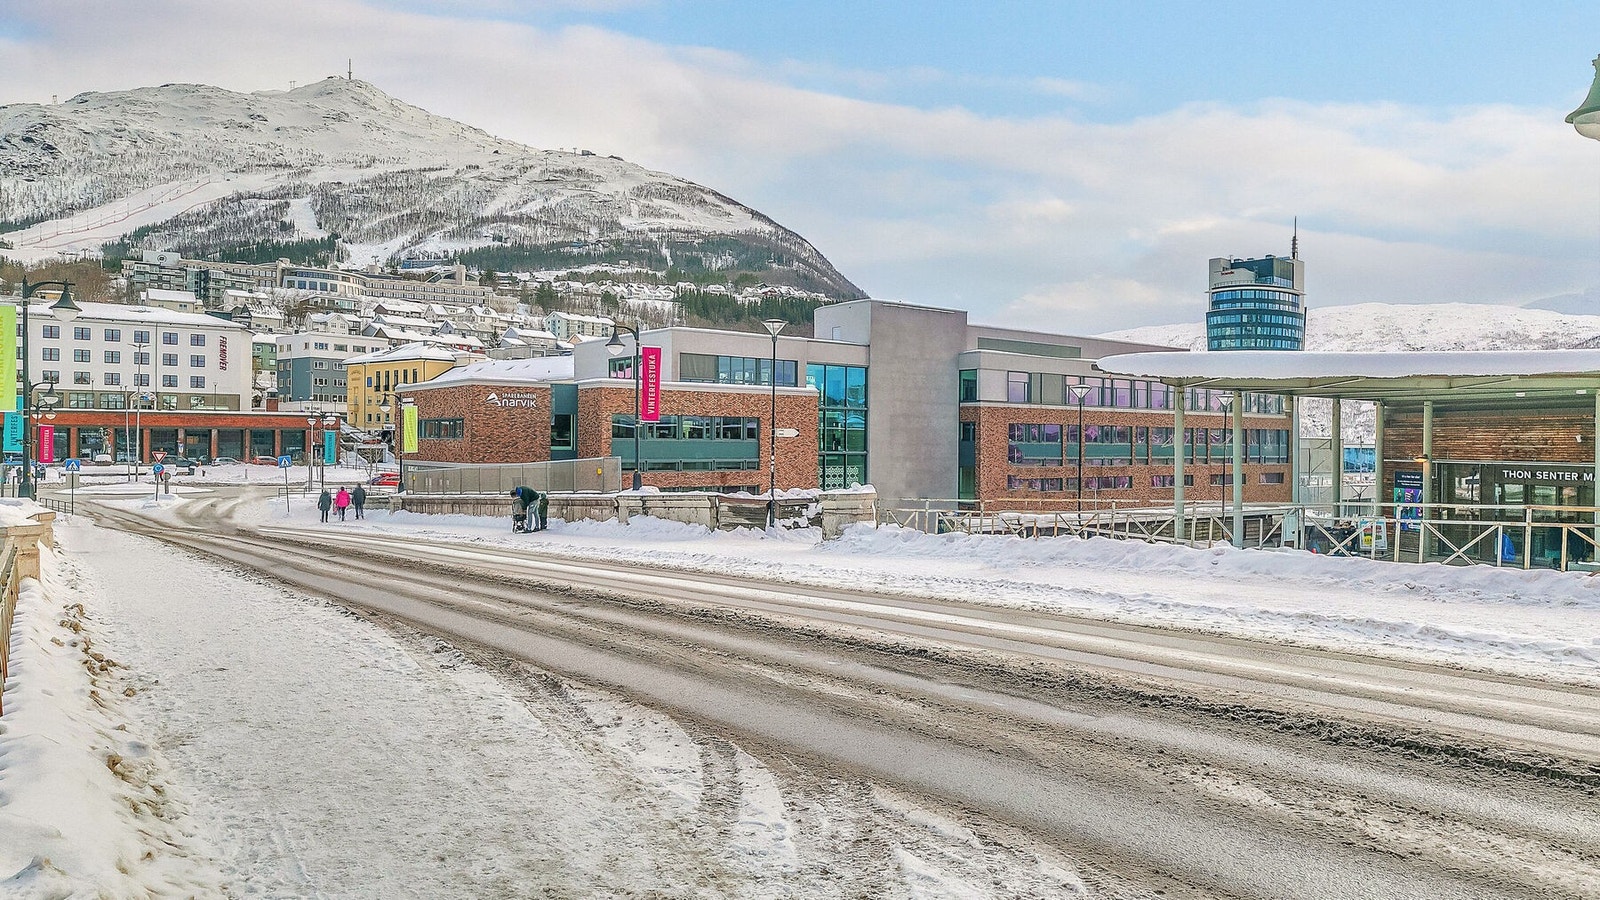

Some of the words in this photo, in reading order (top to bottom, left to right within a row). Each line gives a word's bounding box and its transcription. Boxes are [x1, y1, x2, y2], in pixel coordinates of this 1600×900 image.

[219, 335, 228, 371] FREMOVER
[648, 354, 656, 414] VINTERFESTUKA
[501, 398, 537, 408] narvik
[1502, 469, 1532, 479] THON
[1536, 470, 1579, 481] SENTER
[1583, 472, 1596, 482] M
